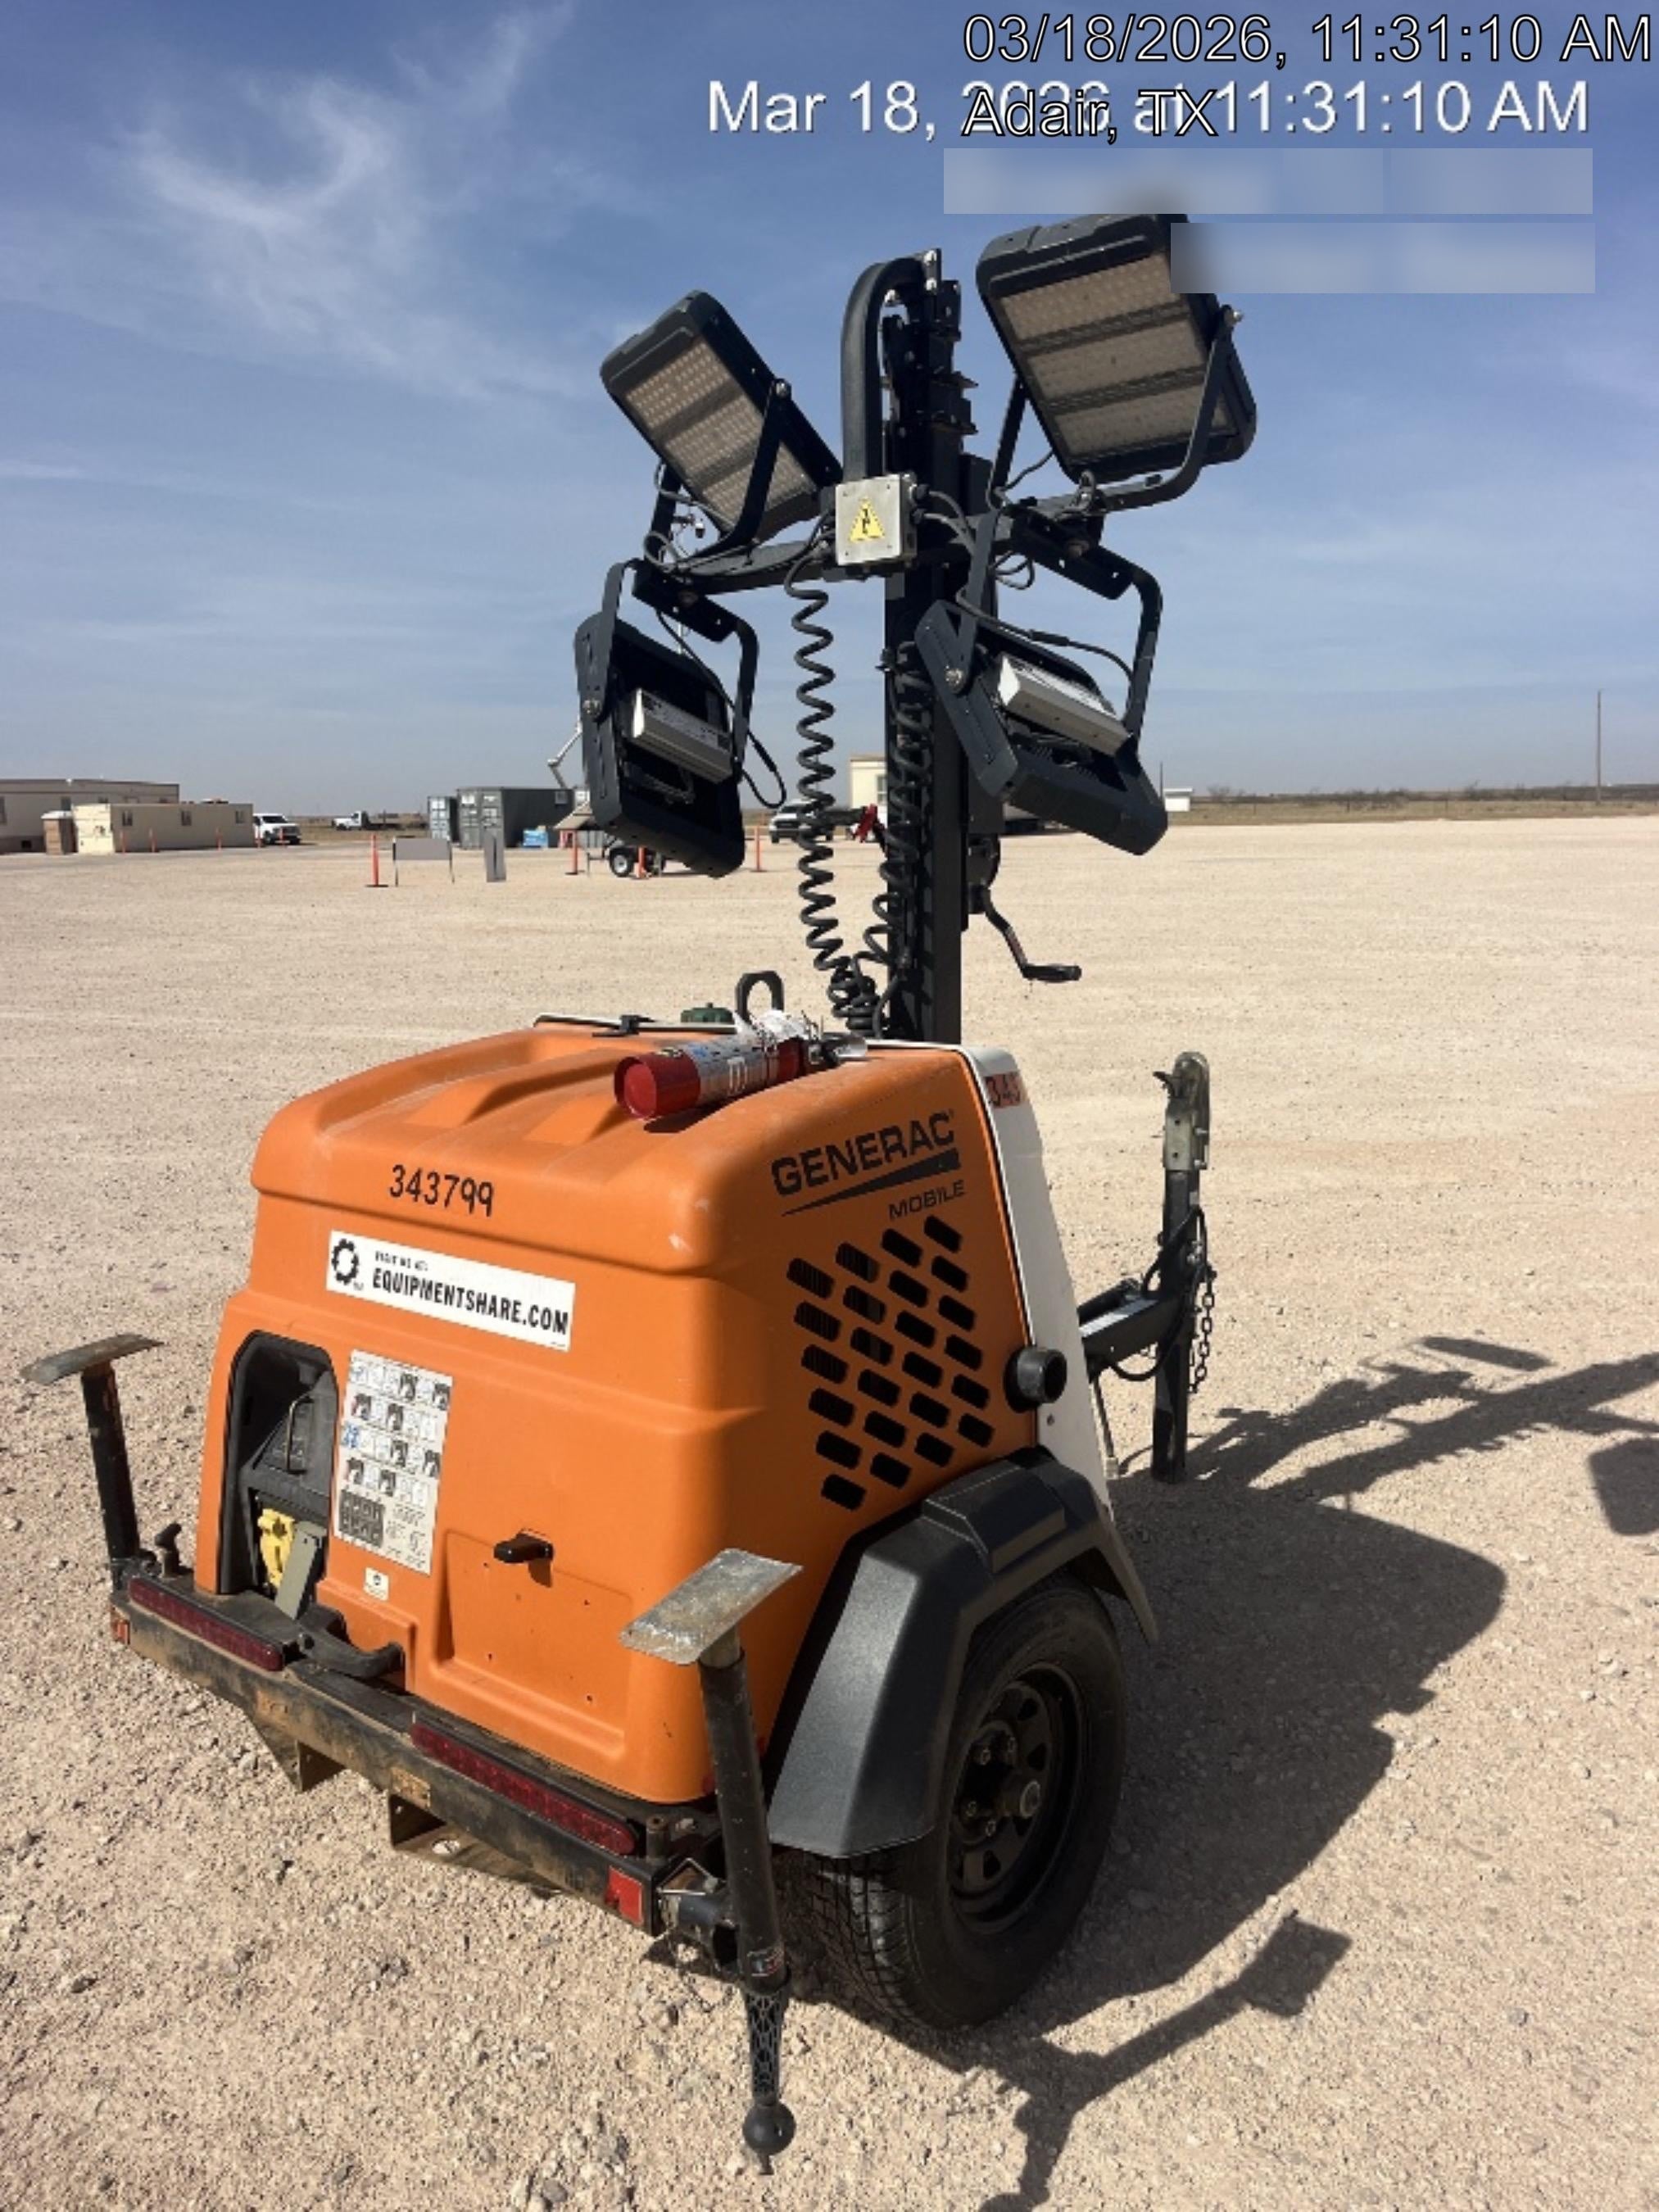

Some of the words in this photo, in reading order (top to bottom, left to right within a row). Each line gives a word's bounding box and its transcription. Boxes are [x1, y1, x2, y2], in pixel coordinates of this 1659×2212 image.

[771, 1110, 954, 1196] GENERAC
[389, 1164, 494, 1217] 343799
[888, 1179, 965, 1221] MOBILE
[372, 1267, 569, 1335] EQUIPMENTSHARE.COM
